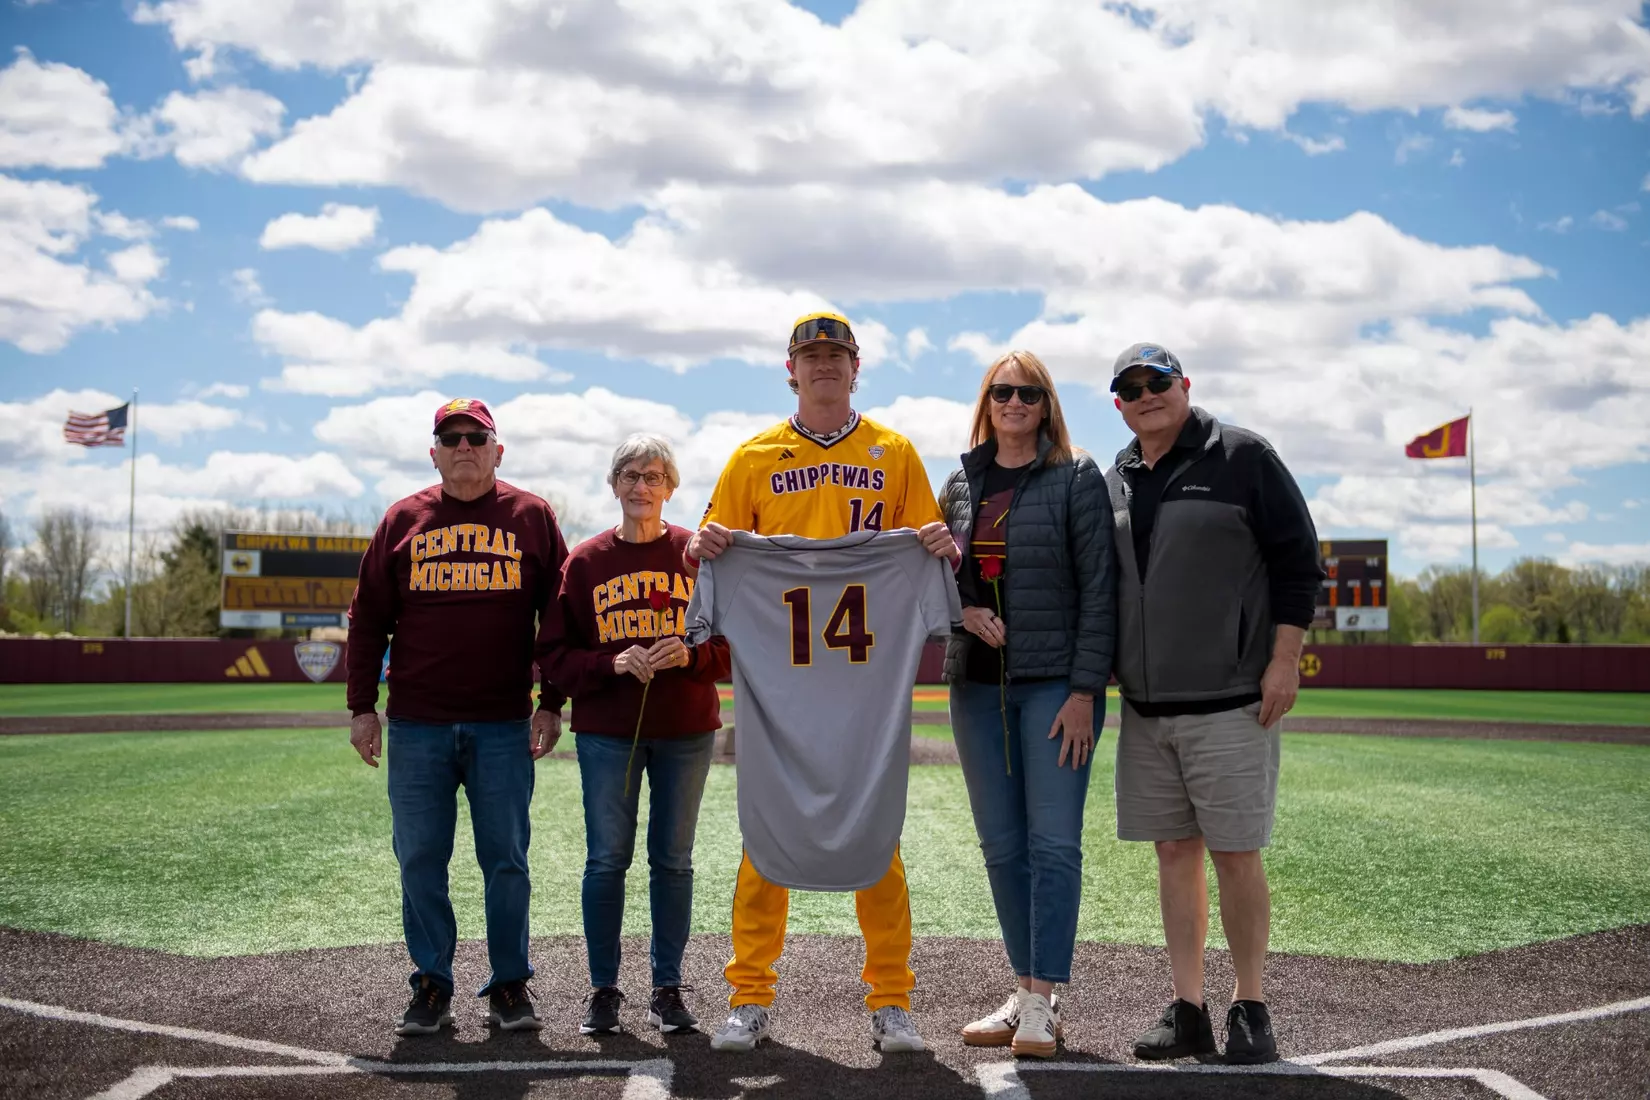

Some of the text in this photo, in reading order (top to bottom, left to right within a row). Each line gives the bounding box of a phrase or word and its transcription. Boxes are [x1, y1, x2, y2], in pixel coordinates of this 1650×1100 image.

[770, 462, 885, 495] CHIPPEWAS
[848, 498, 885, 533] 14
[236, 533, 309, 550] CHIPPEWA
[410, 523, 522, 562] CENTRAL
[409, 561, 522, 591] MICHIGAN
[596, 606, 687, 644] MICHIGA
[782, 583, 875, 667] 14
